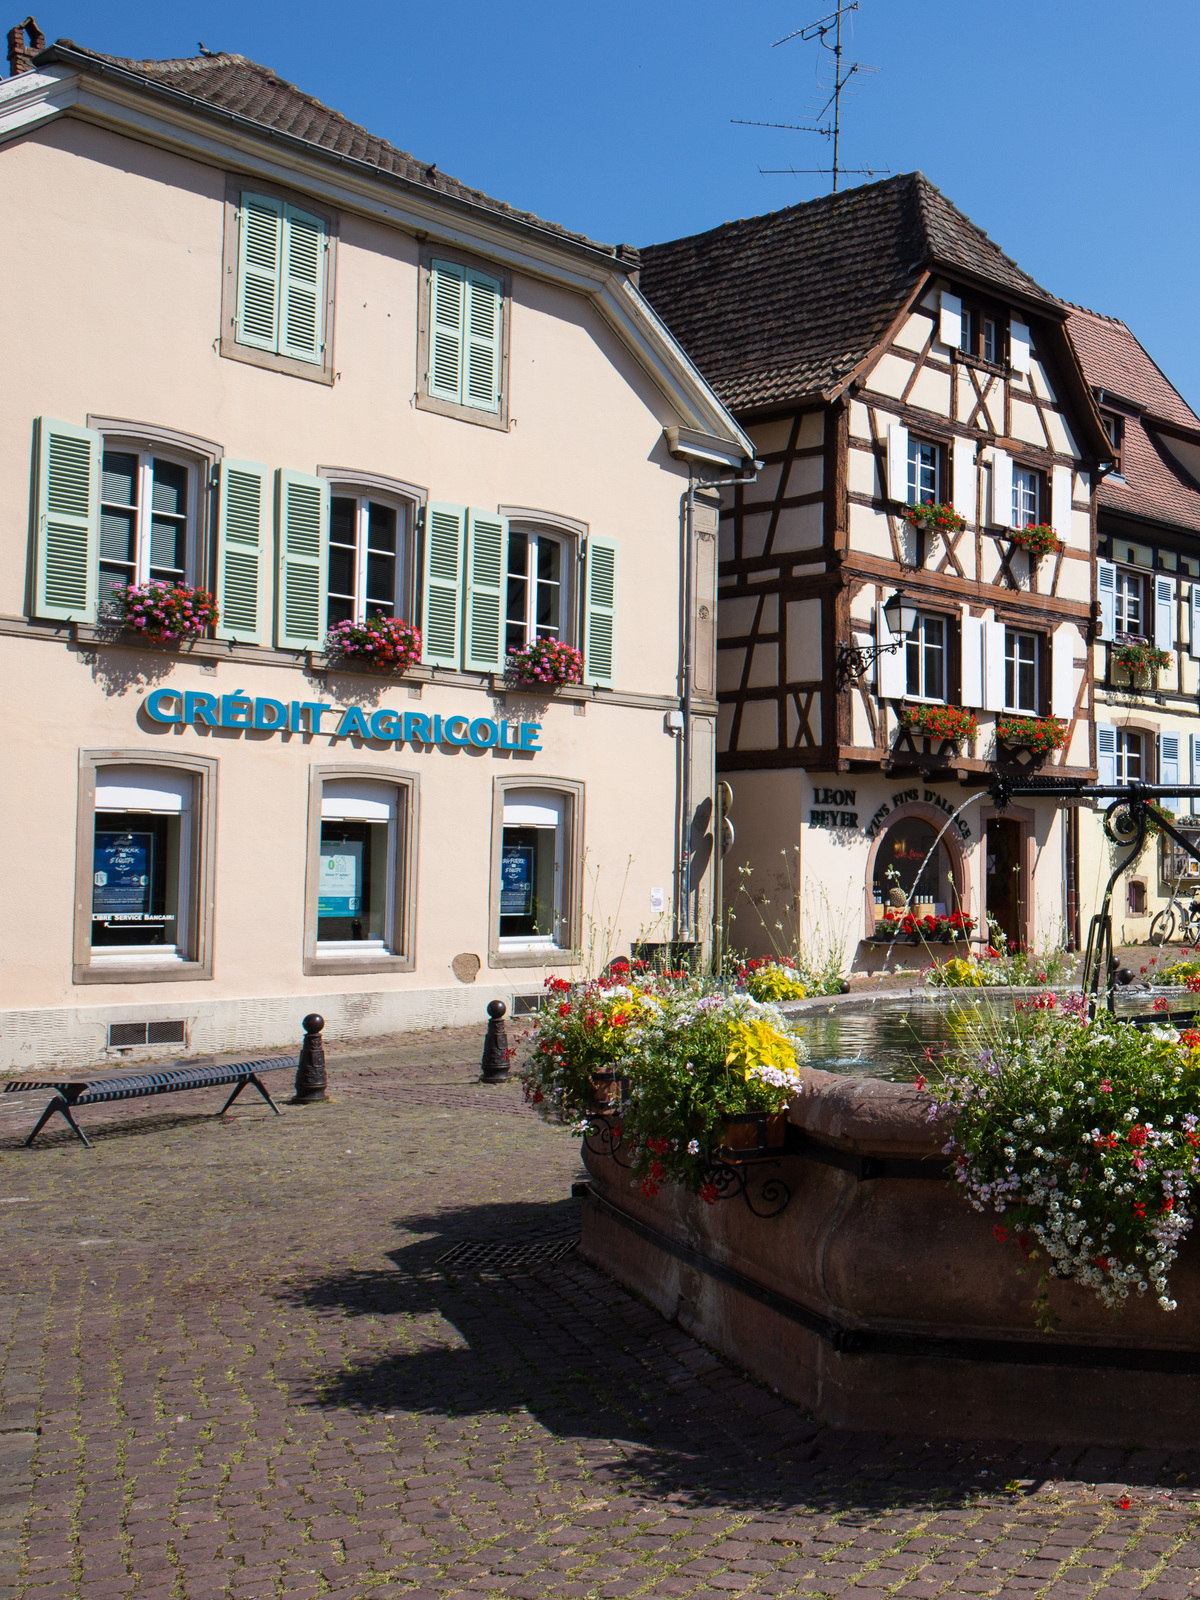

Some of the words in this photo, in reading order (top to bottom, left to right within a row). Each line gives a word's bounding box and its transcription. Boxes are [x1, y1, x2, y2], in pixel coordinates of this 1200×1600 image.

[145, 688, 332, 734] CRÉDIT
[336, 706, 543, 752] AGRICOLE
[813, 788, 857, 806] LEON
[867, 803, 891, 837] VINS
[891, 788, 919, 808] FINS
[810, 810, 859, 829] BEYER
